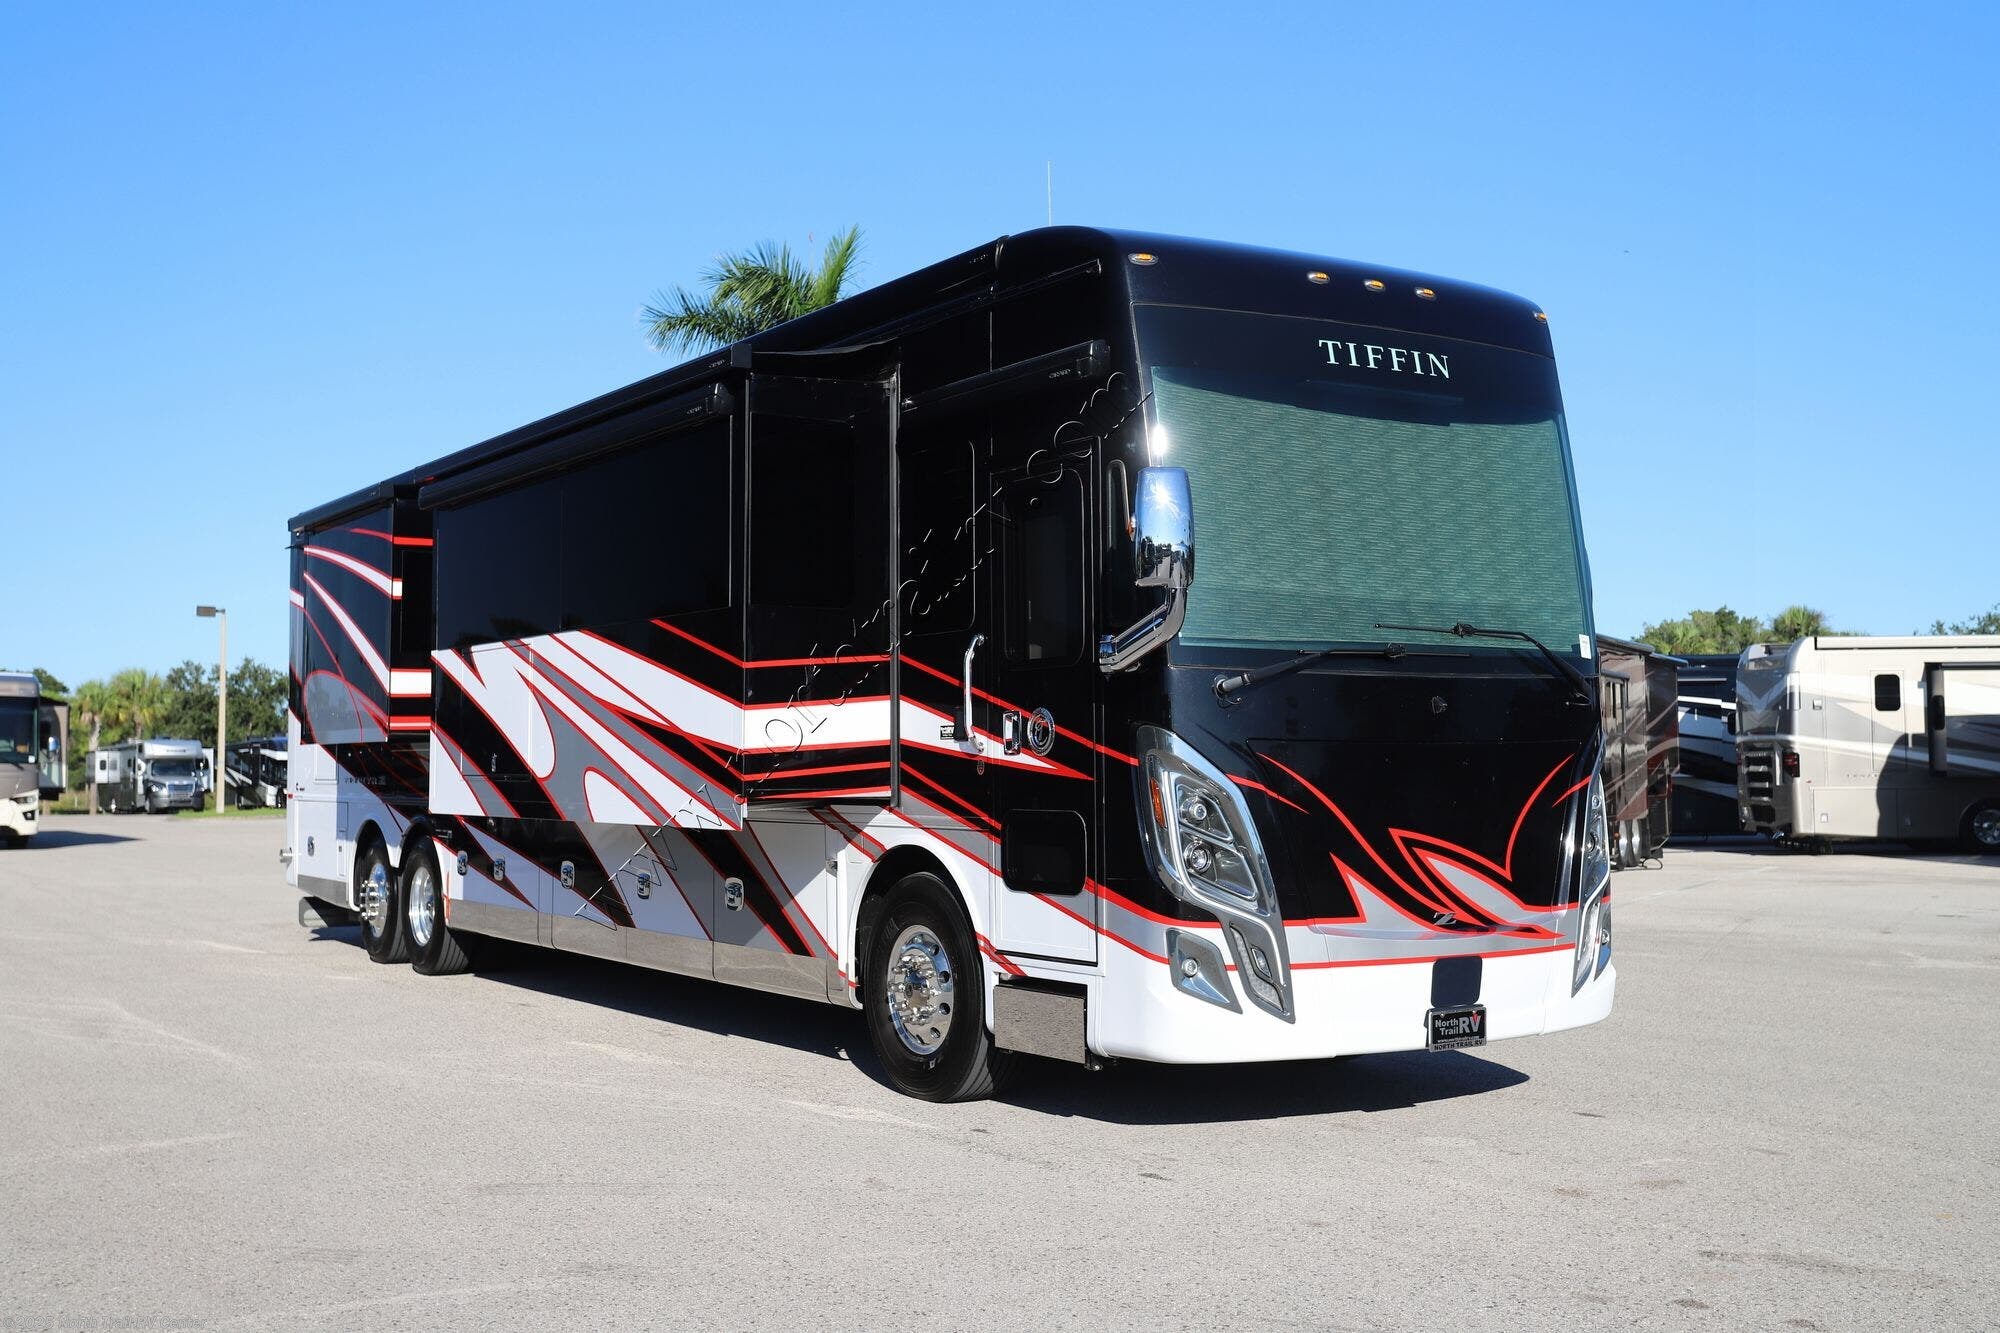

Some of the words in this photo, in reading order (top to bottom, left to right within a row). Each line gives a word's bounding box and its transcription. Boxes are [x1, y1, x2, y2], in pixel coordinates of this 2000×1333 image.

[1319, 339, 1450, 379] TIFFIN
[1435, 1018, 1459, 1028] North
[1459, 1015, 1482, 1034] RV
[1440, 1027, 1459, 1036] Trail
